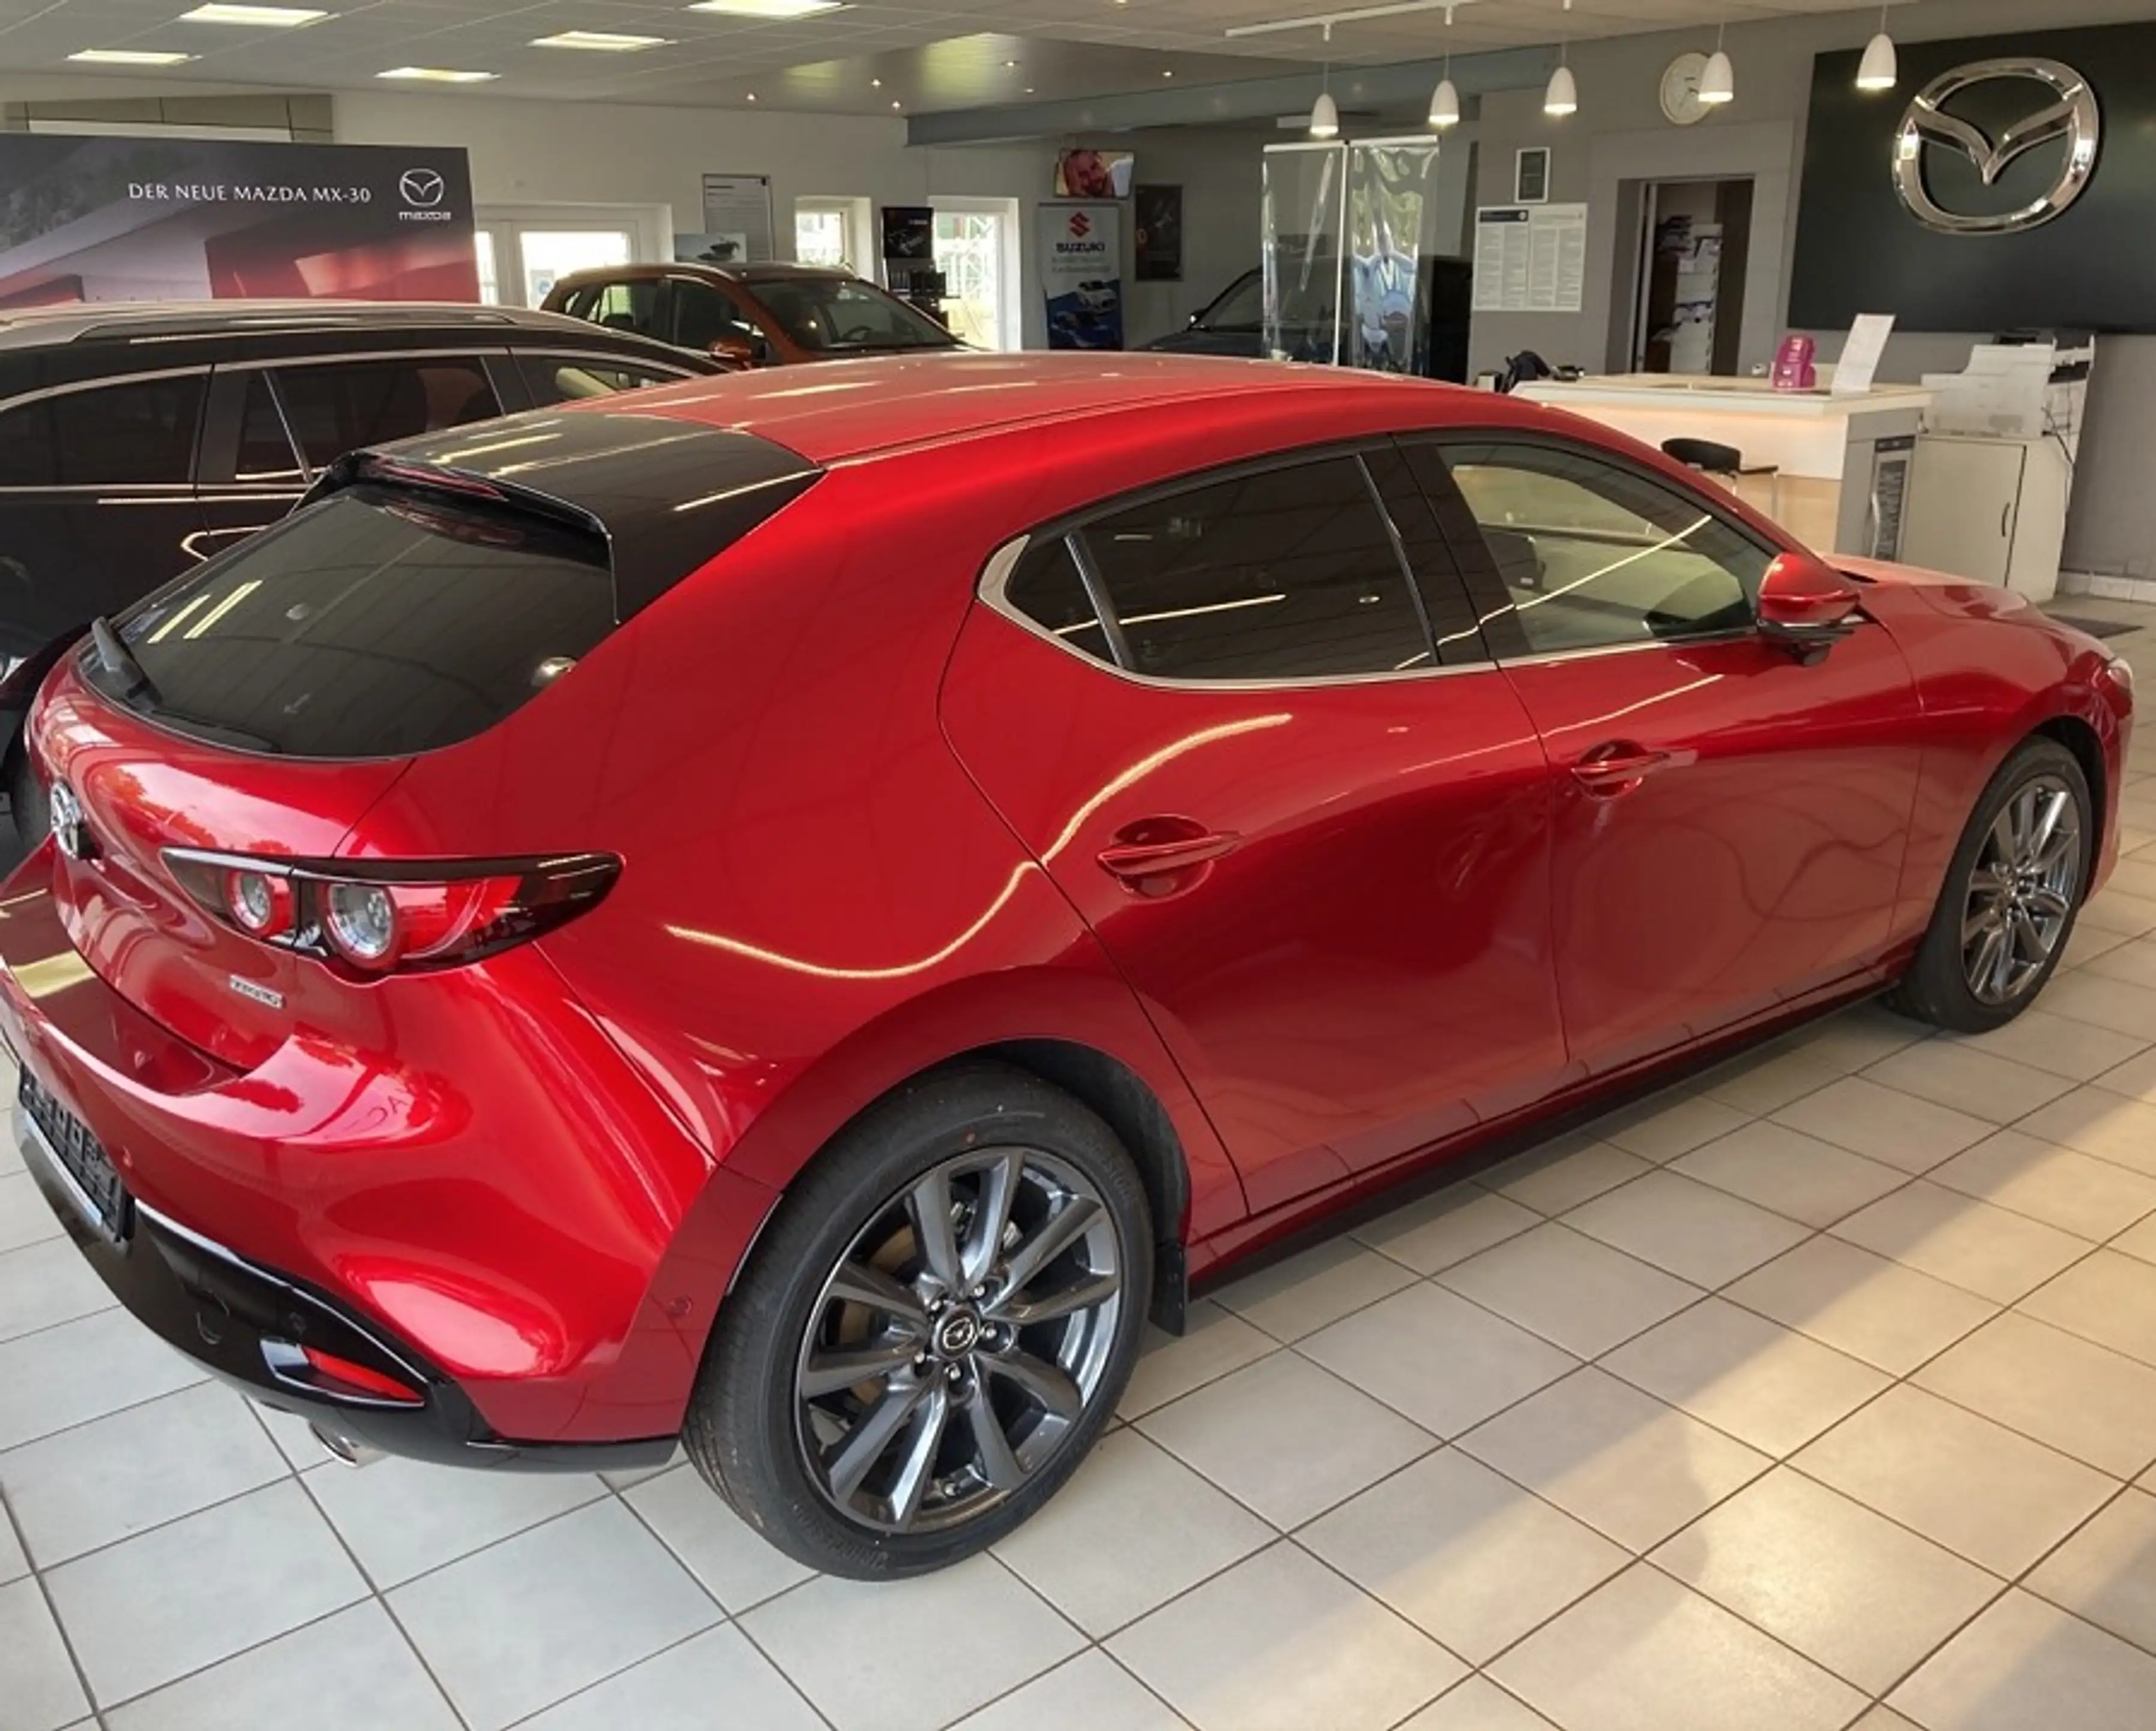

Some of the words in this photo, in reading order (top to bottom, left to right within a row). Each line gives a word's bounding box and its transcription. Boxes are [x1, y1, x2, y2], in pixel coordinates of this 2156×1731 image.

[127, 183, 169, 200] DER
[175, 184, 228, 201] NEUE
[233, 185, 308, 203] MAZDA
[312, 187, 371, 203] MX-30
[398, 211, 452, 221] mazda
[1056, 242, 1106, 253] SUZUKI
